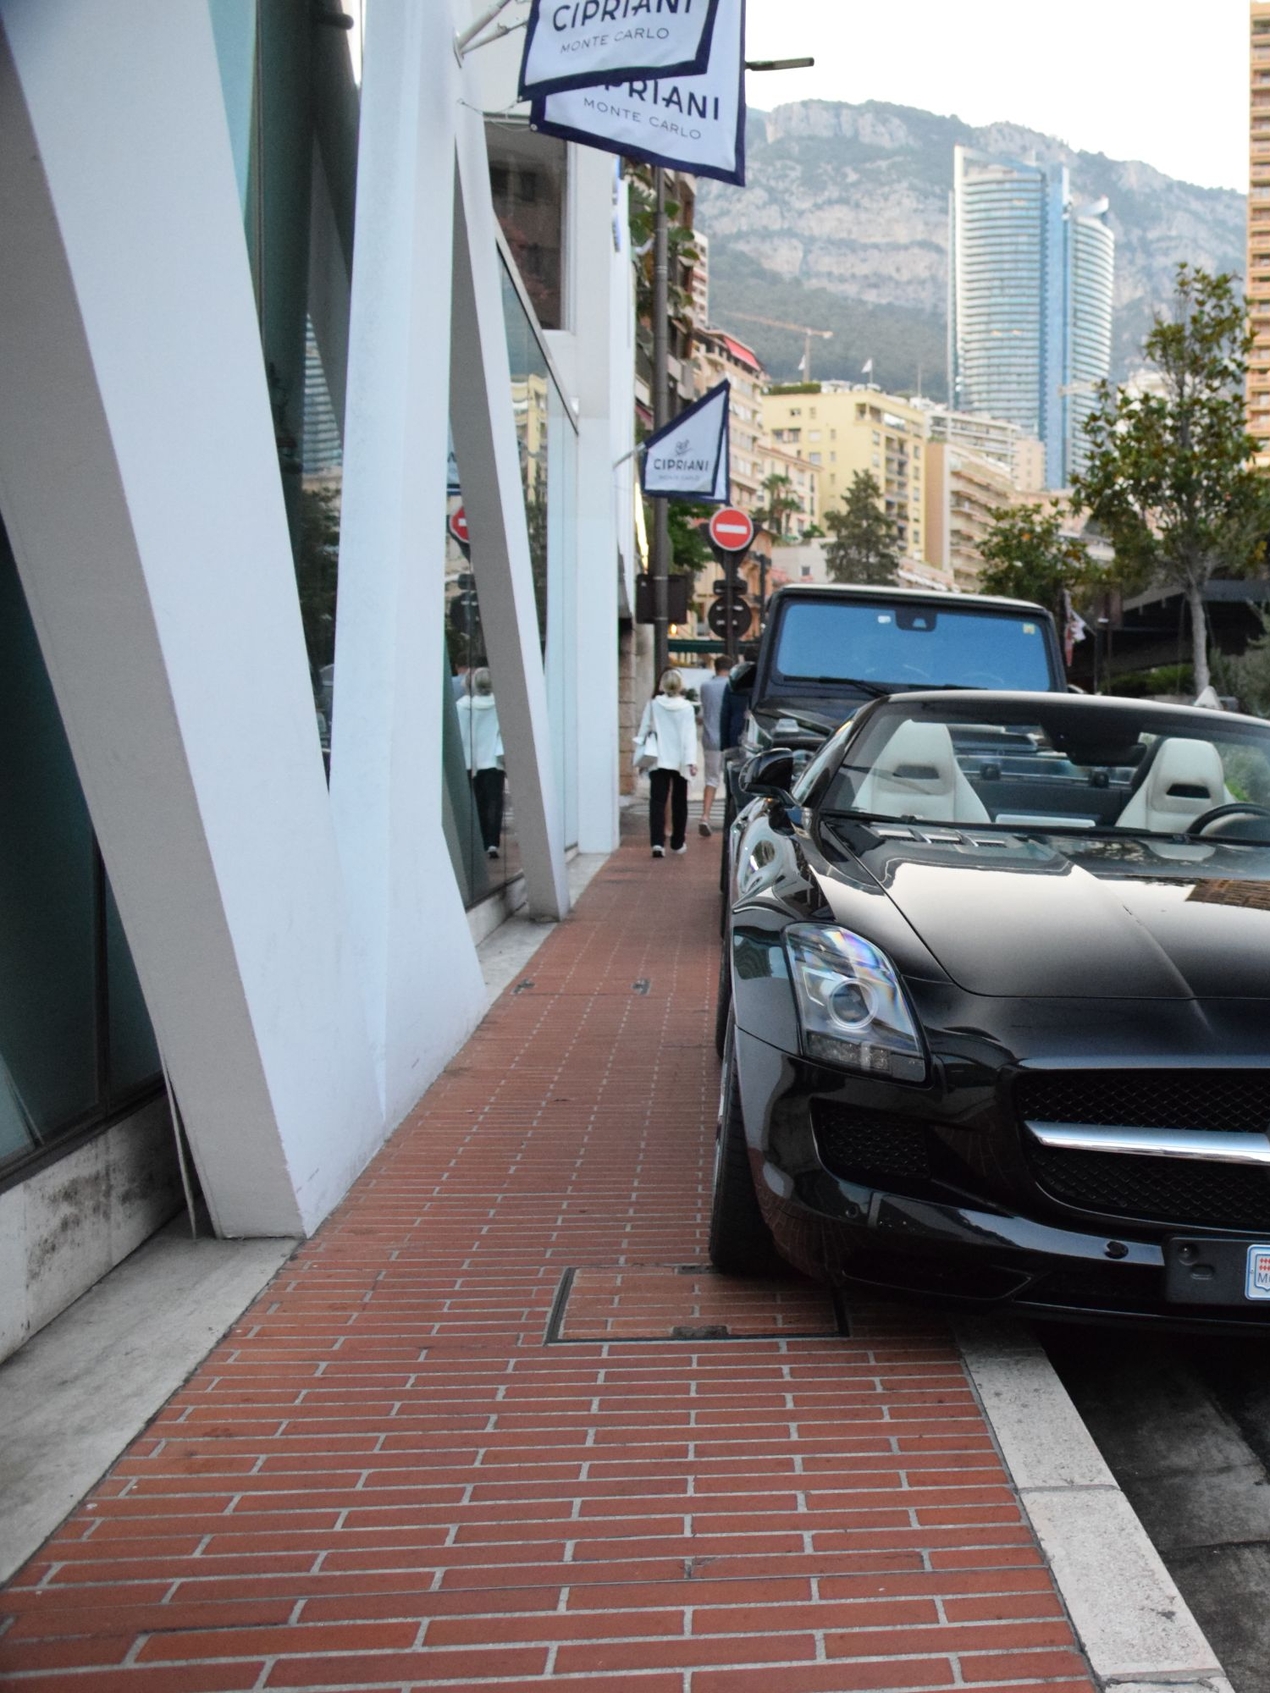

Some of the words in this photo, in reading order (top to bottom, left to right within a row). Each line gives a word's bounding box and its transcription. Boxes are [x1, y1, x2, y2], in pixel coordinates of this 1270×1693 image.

[560, 35, 609, 53] MONTE
[614, 28, 670, 42] CARLO
[583, 98, 642, 123] MONTE
[648, 116, 702, 140] CARLO
[653, 458, 709, 471] CIPRIANI
